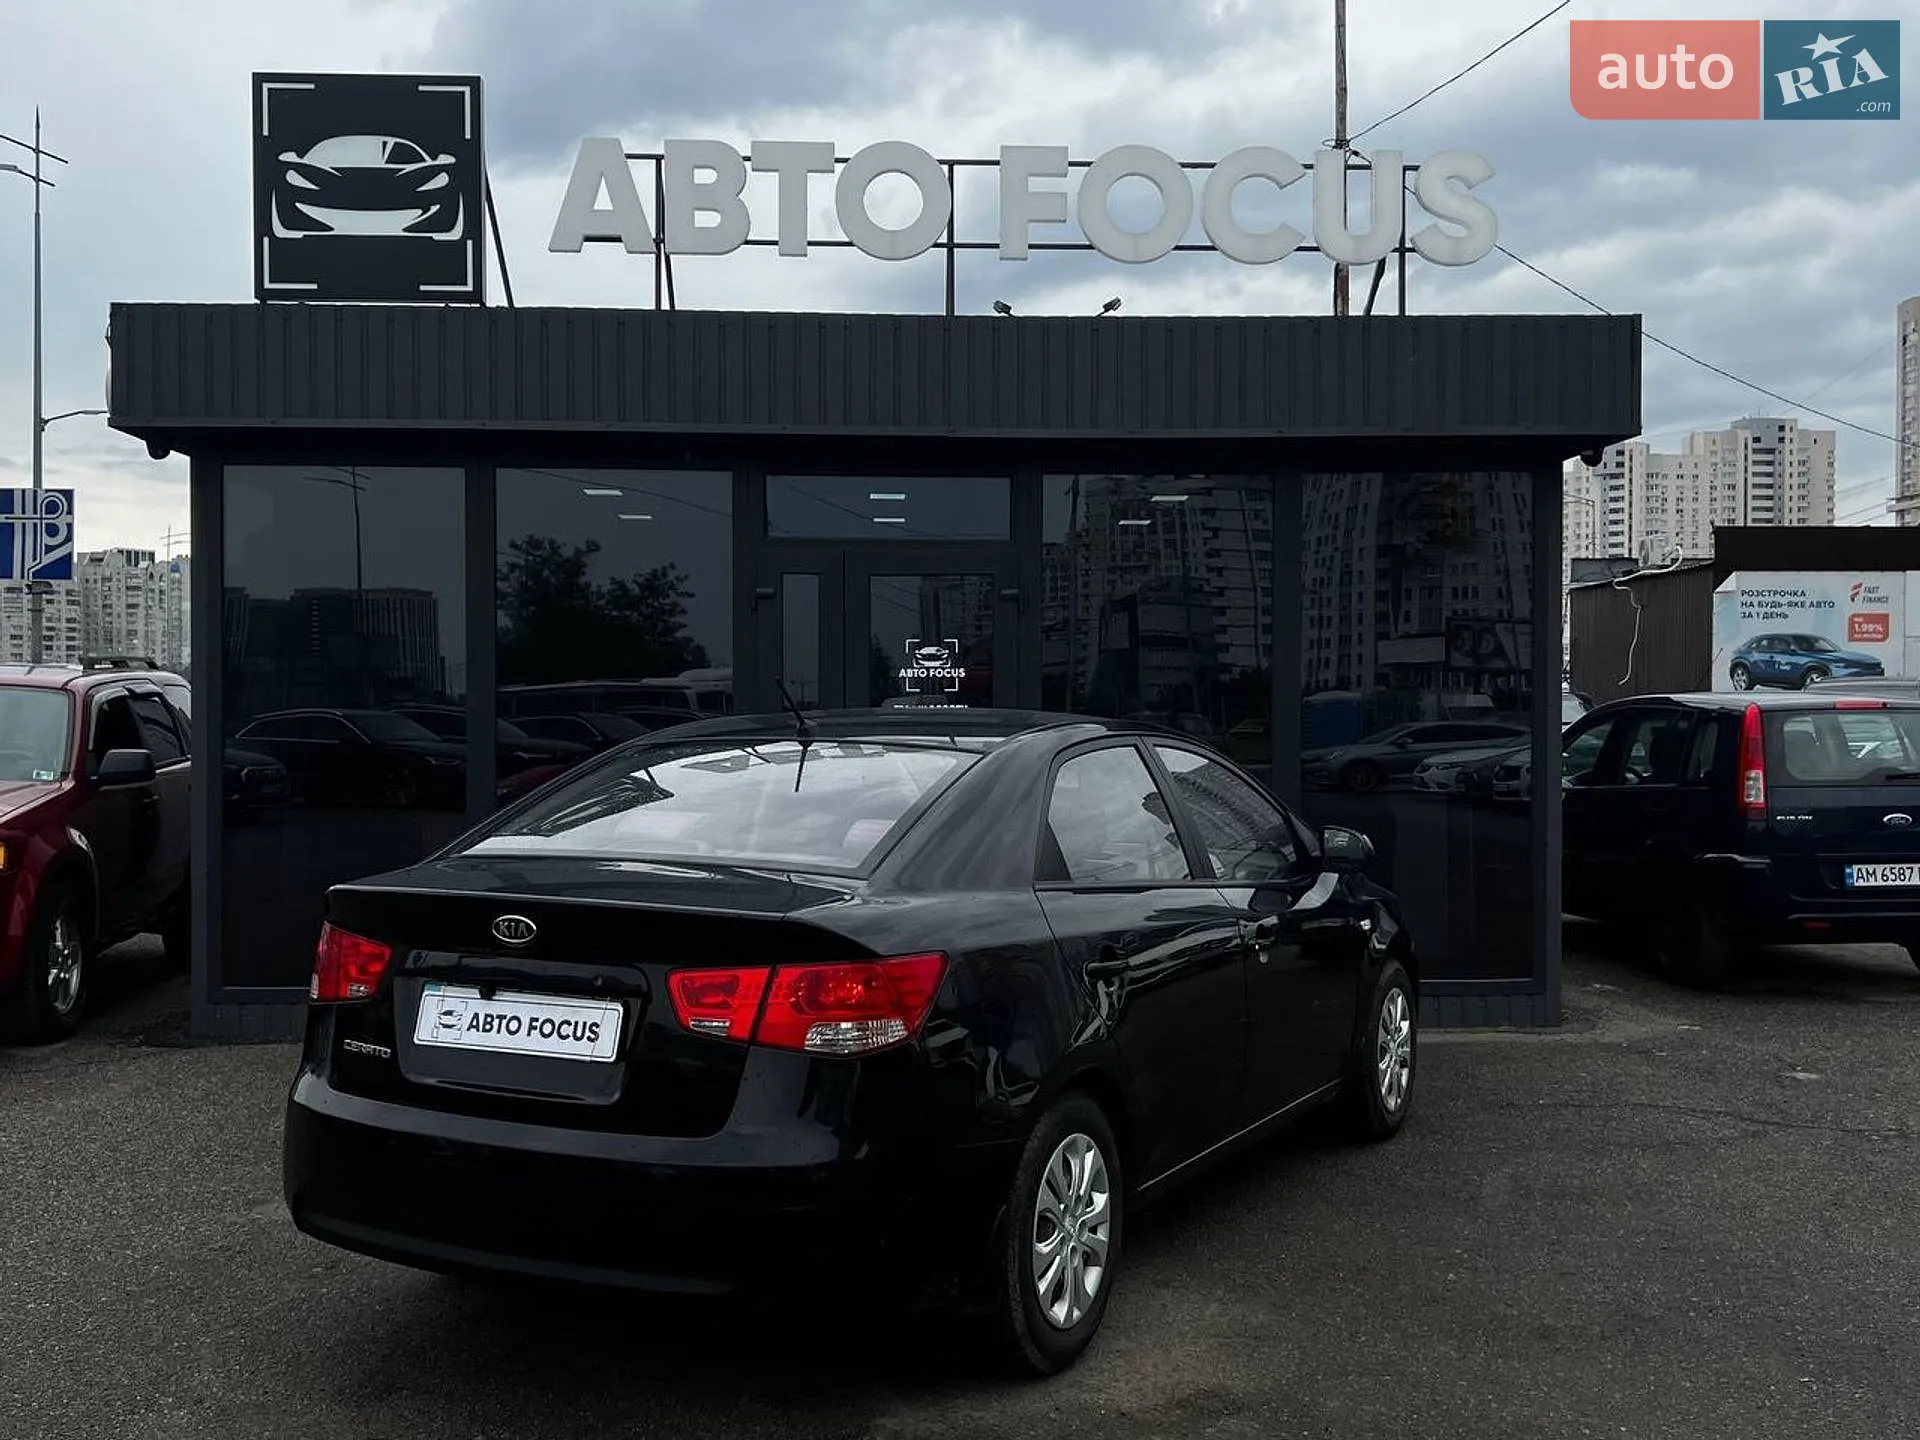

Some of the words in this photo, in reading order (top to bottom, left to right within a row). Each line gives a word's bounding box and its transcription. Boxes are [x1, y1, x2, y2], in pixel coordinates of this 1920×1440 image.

[548, 137, 953, 261] АВТО
[999, 143, 1500, 267] FOCUS
[1740, 588, 1807, 598] РОЗСТРОЧКА
[1740, 600, 1754, 609] НА
[1757, 600, 1806, 610] БУДЬ-ЯКЕ
[1808, 600, 1836, 609] АВТО
[1740, 612, 1754, 620] ЗА
[1762, 612, 1789, 621] ДЕНЬ
[929, 667, 966, 678] FOCUS
[1855, 866, 1878, 883] AM
[1881, 866, 1914, 882] 6587
[499, 920, 529, 937] KIA
[526, 1016, 601, 1043] FOCUS
